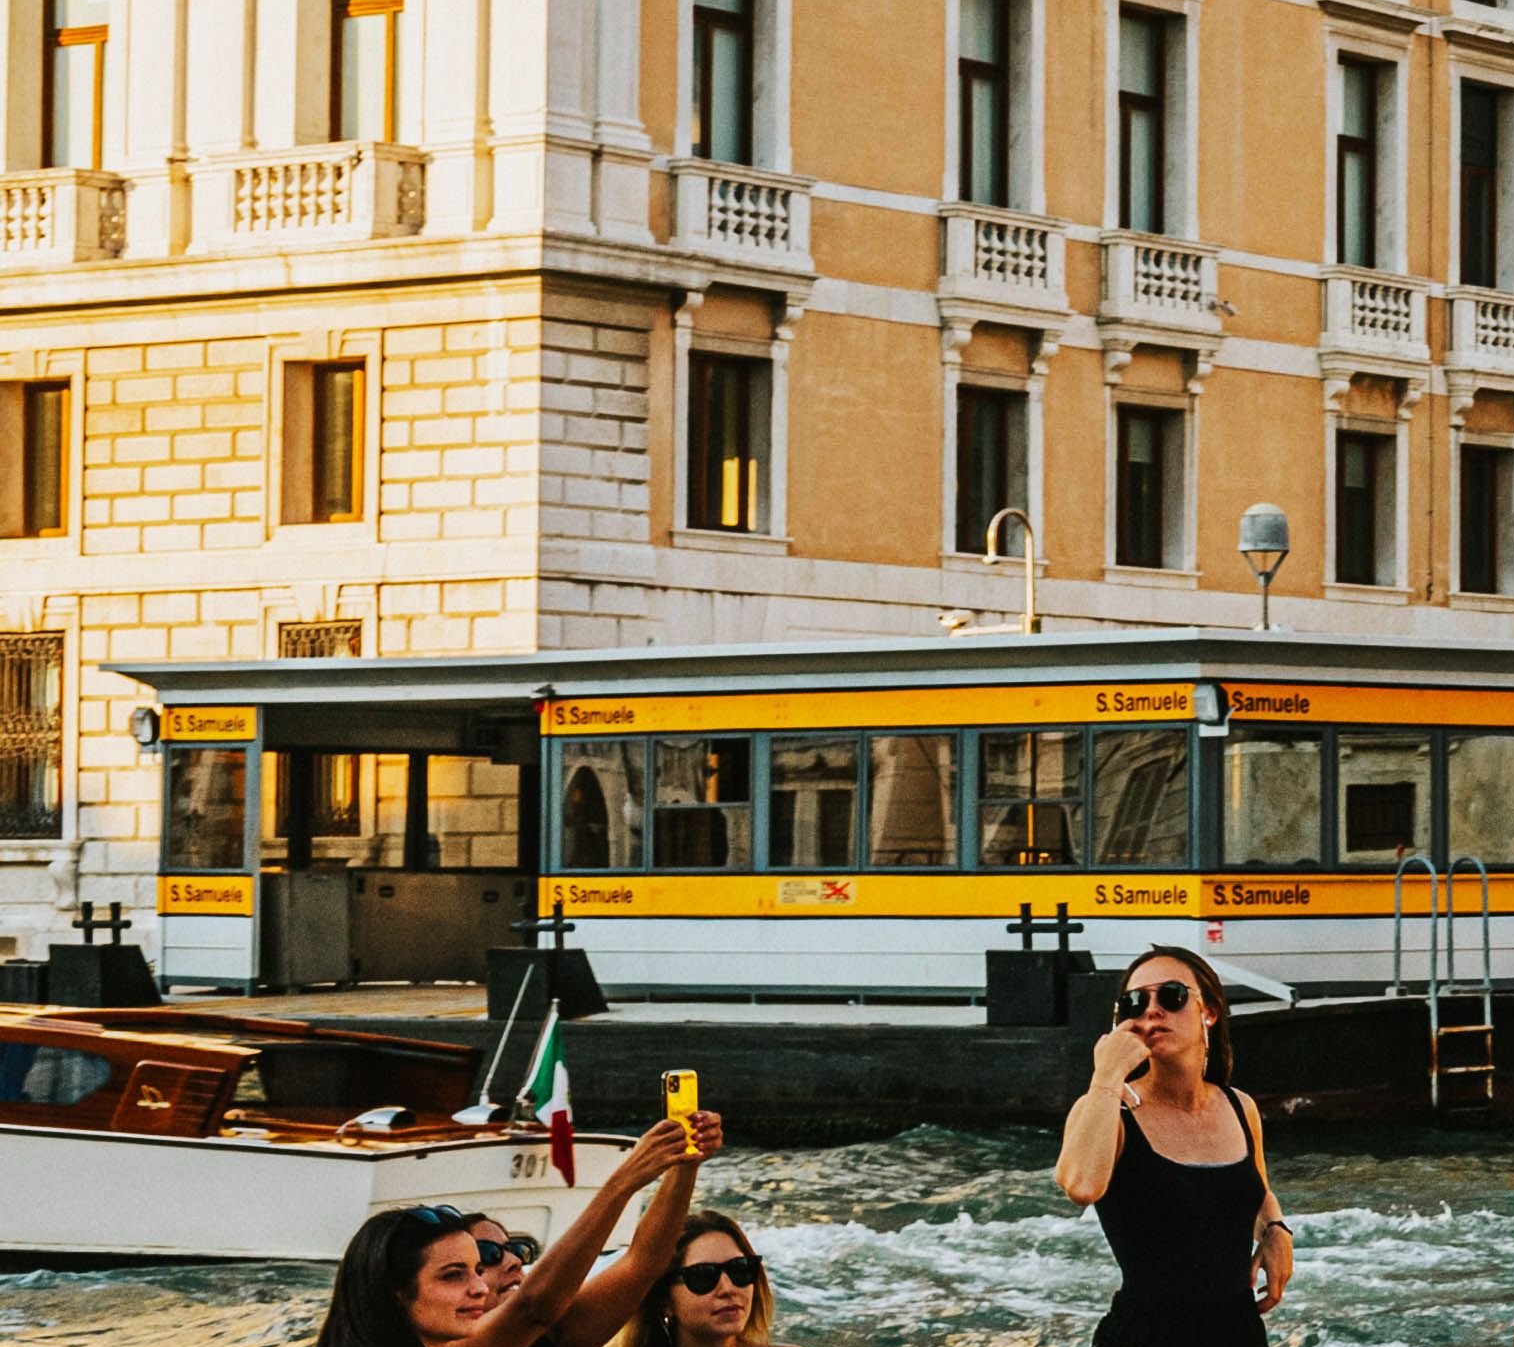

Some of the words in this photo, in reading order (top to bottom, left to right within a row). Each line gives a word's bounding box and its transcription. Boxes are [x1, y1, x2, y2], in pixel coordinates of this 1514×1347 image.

[1096, 692, 1110, 713] S.
[1113, 690, 1188, 712] Samuele
[1231, 690, 1310, 714] Samuele
[173, 714, 185, 733] S.
[187, 714, 246, 732] Samuele
[555, 706, 567, 726] S.
[569, 706, 635, 725] Samuele
[170, 884, 181, 903] S.
[184, 884, 243, 903] Samuele
[569, 885, 633, 904] Samuele
[1095, 884, 1110, 905] S.
[1112, 884, 1188, 905] Samuele
[1213, 884, 1230, 905] S.
[1231, 883, 1311, 905] Samuele
[510, 1153, 549, 1179] 301
